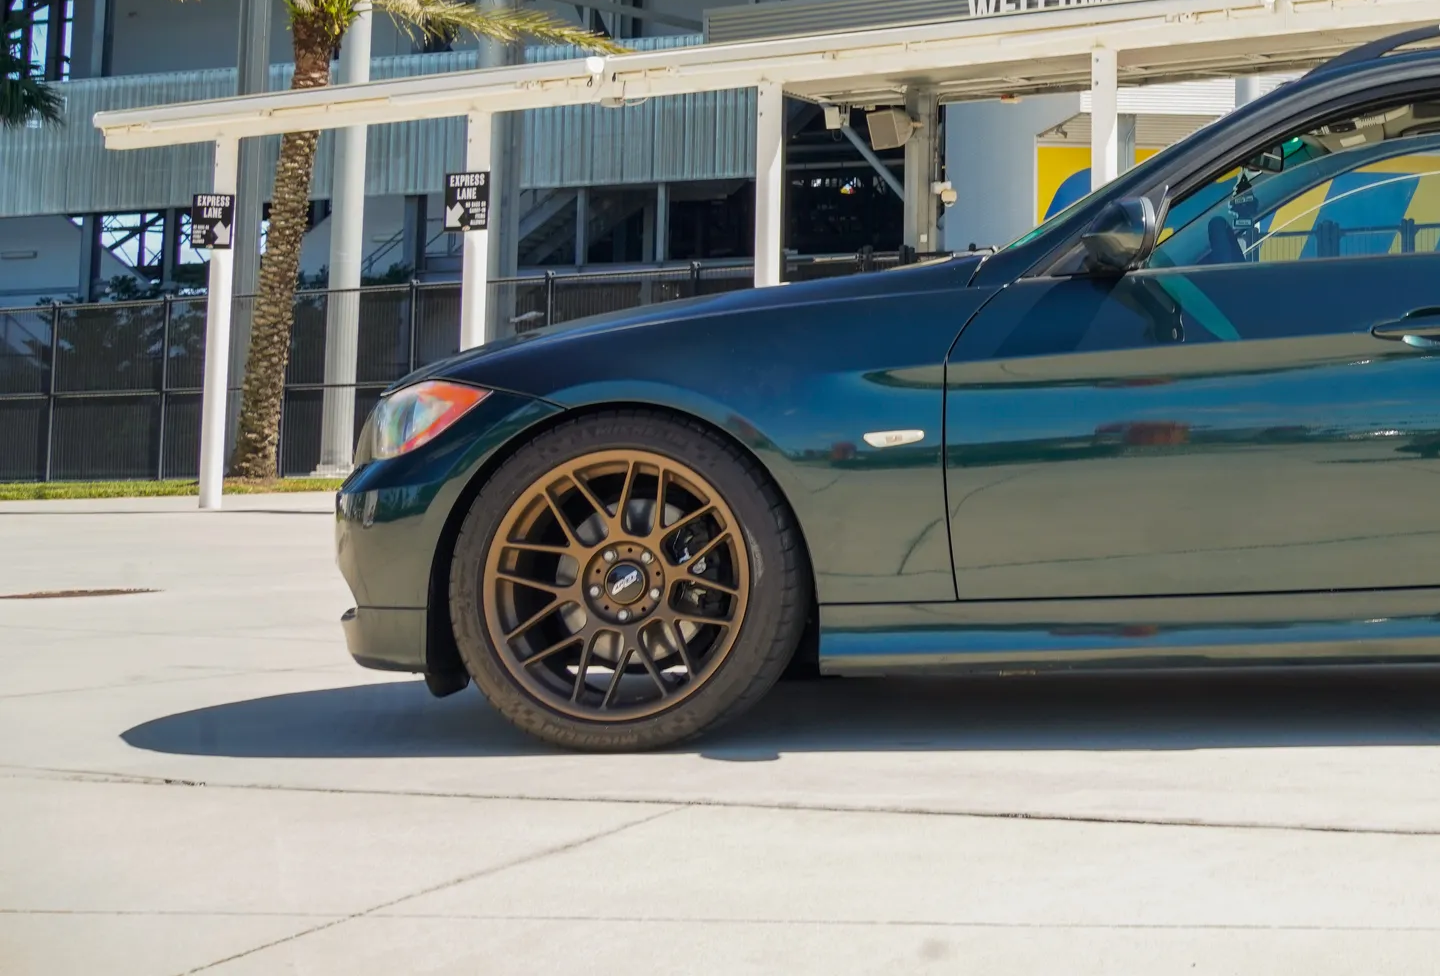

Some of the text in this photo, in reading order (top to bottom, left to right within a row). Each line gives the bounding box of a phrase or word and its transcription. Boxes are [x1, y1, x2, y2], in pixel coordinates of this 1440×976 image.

[450, 173, 485, 187] EXPRESS
[457, 187, 477, 200] LANE
[197, 195, 231, 207] EXPRESS
[203, 207, 222, 219] LANE
